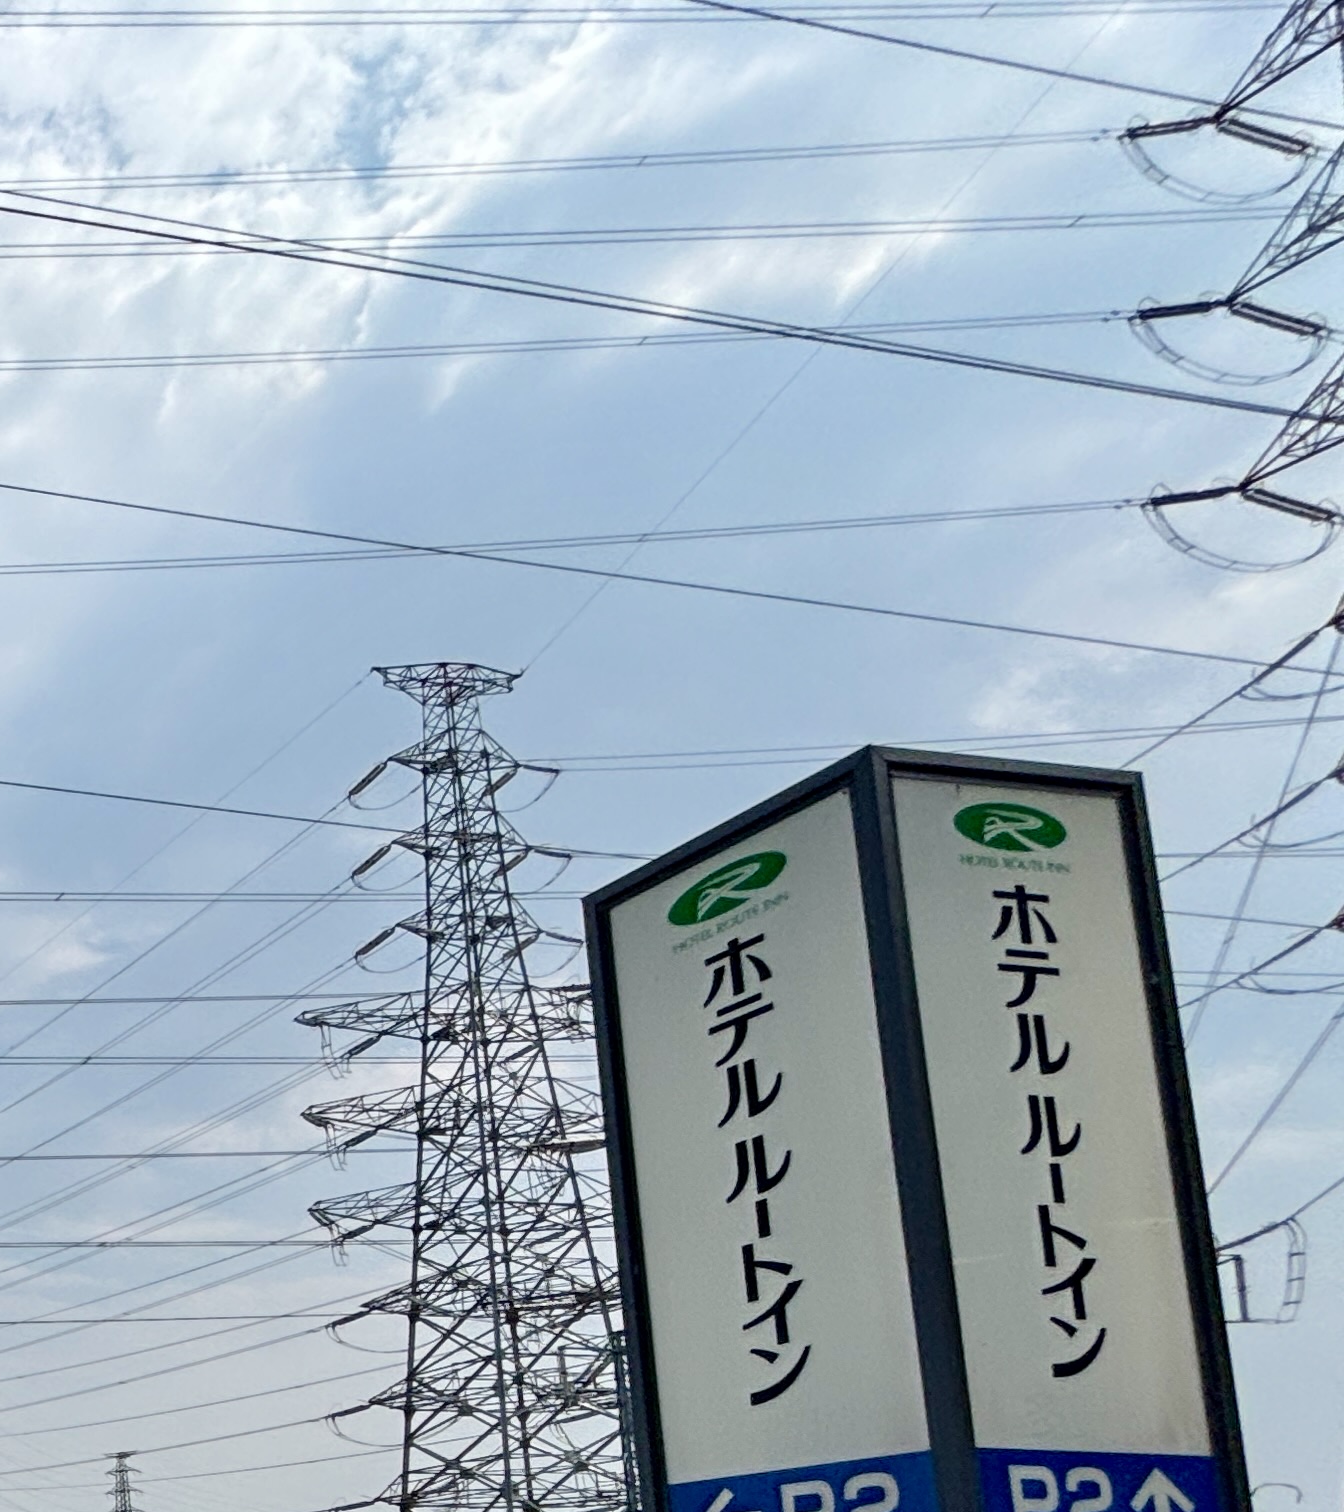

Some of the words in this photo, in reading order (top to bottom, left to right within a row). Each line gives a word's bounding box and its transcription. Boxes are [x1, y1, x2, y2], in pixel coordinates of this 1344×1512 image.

[703, 933, 812, 1407] ホテルルートイン
[992, 884, 1107, 1378] ホテルルートイン
